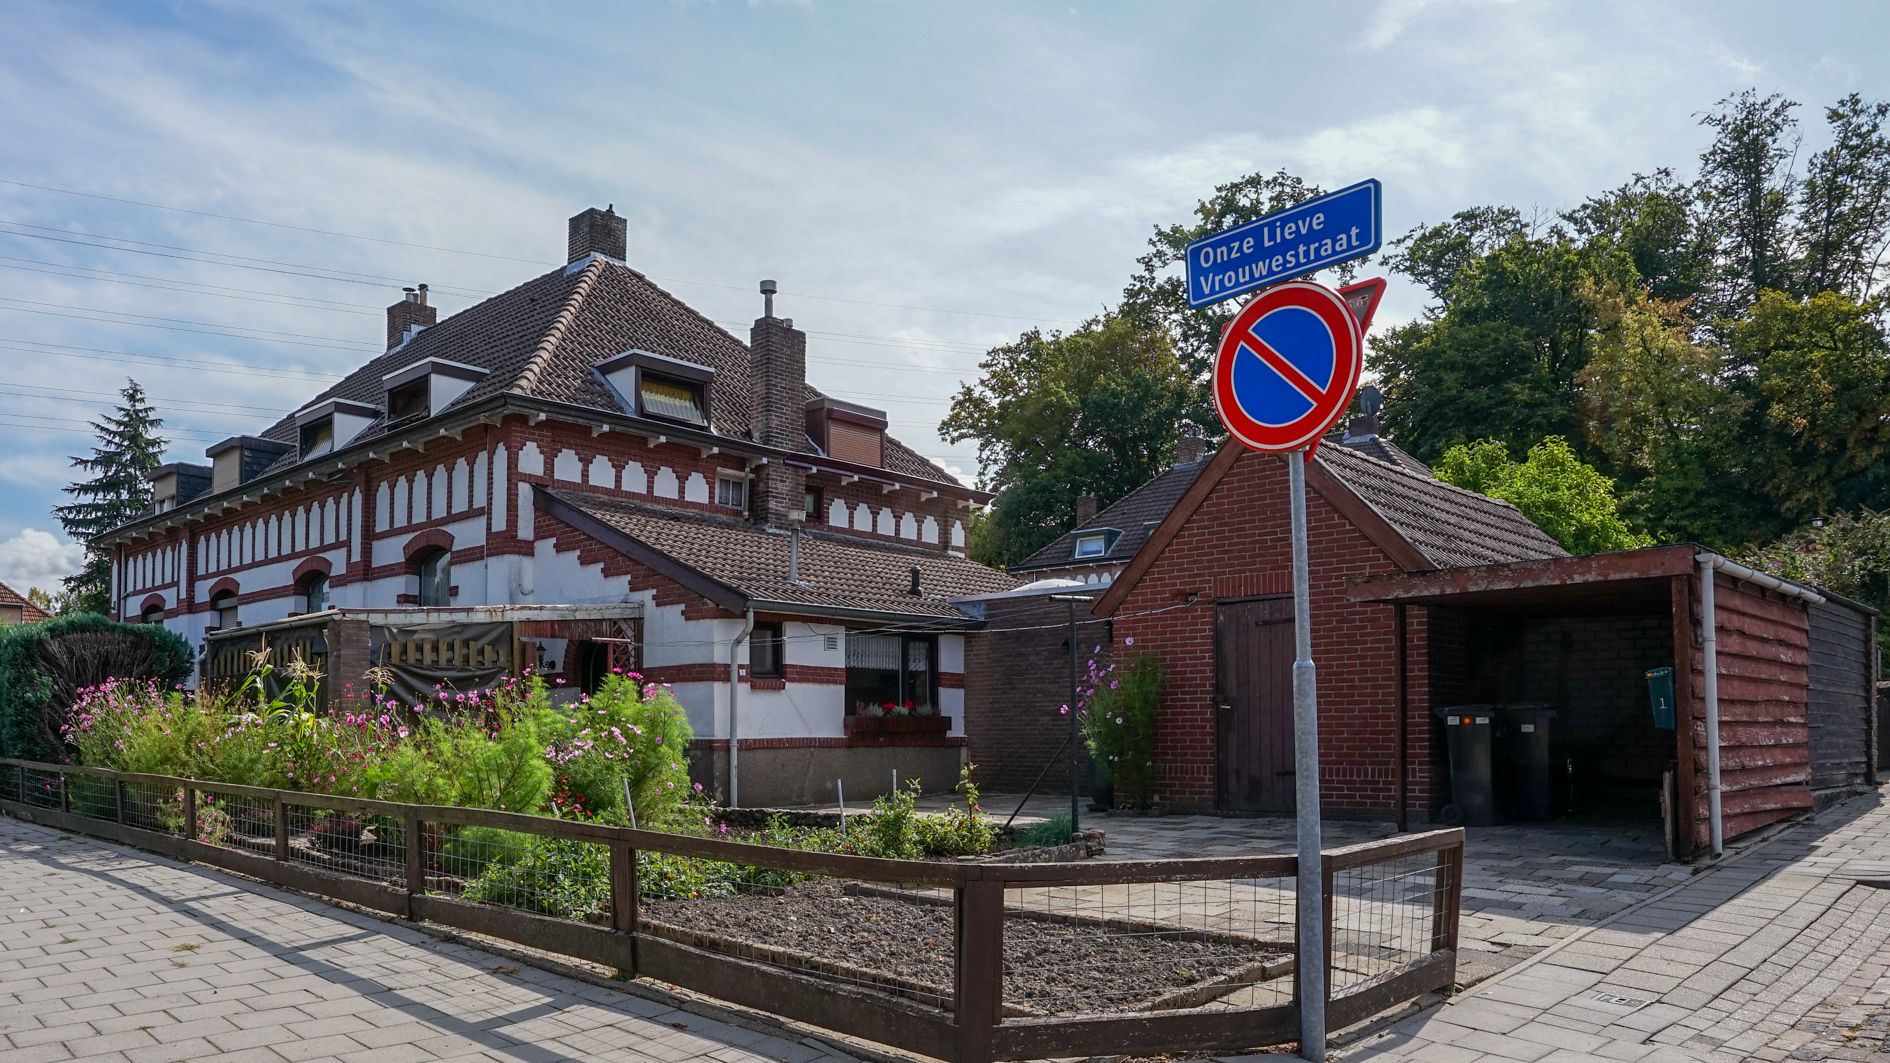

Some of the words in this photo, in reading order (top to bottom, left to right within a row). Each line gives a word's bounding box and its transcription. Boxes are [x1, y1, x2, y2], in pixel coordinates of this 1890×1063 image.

[1200, 237, 1255, 268] Onze
[1264, 212, 1325, 247] Lieve
[1200, 225, 1360, 295] Vrouwestraat
[1659, 697, 1668, 709] 1
